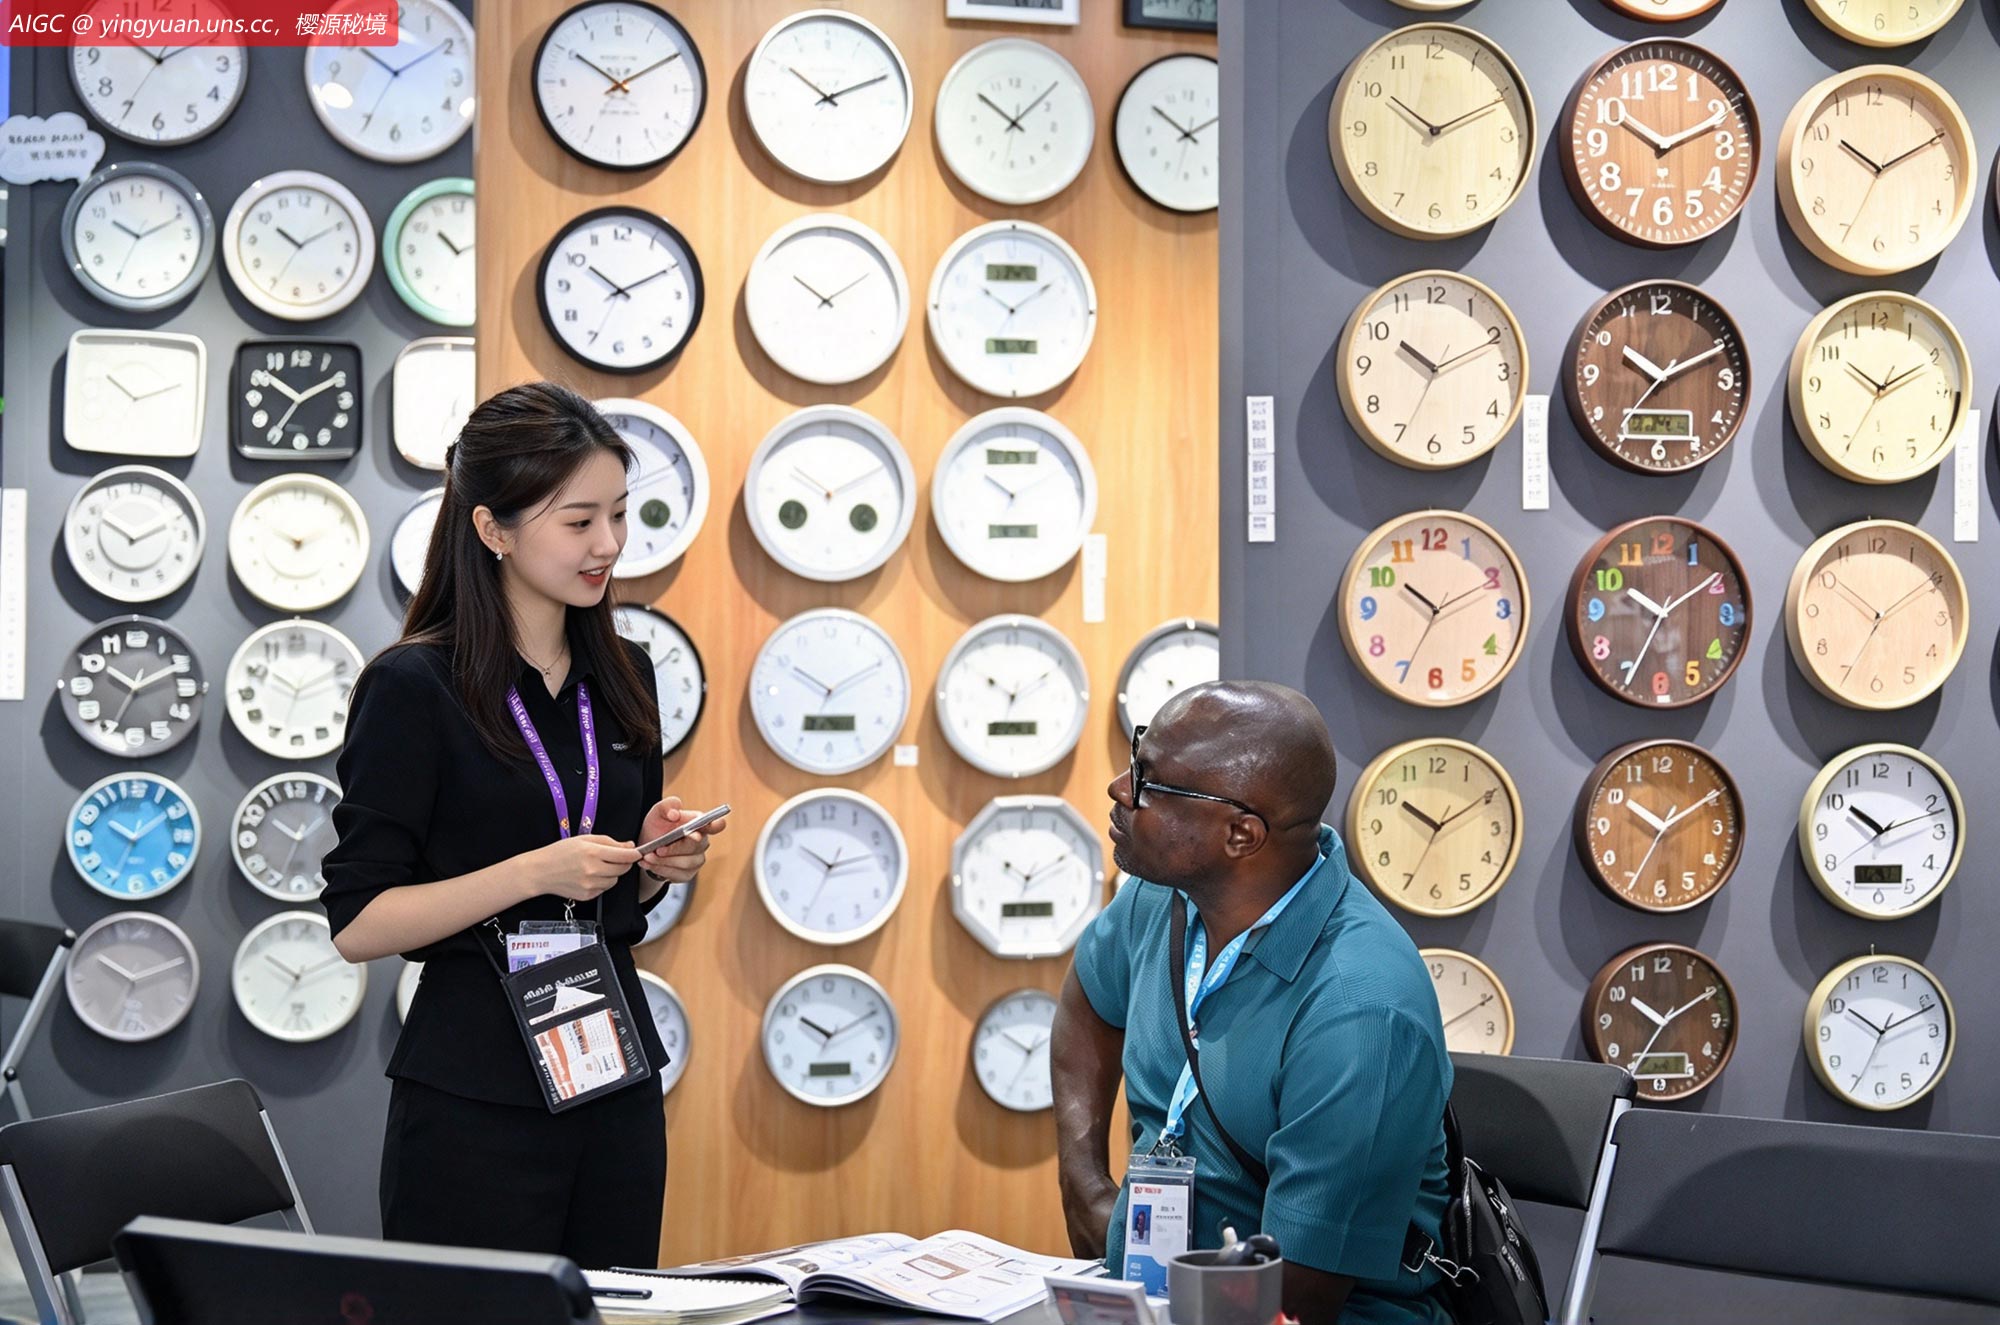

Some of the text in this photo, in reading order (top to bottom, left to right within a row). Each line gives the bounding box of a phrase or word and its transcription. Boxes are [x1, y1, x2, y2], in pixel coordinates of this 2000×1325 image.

[1874, 13, 1885, 31] 6
[88, 48, 100, 65] 9
[1426, 44, 1444, 60] 12
[216, 55, 229, 73] 3
[1392, 56, 1404, 69] 11
[98, 77, 113, 96] 8
[1620, 71, 1645, 99] 11
[1648, 64, 1678, 91] 12
[1687, 72, 1700, 101] 1
[207, 86, 219, 101] 4
[1364, 82, 1382, 97] 10
[1866, 85, 1884, 106] 12
[122, 100, 134, 119] 7
[185, 104, 198, 123] 5
[1597, 97, 1627, 126] 10
[1835, 93, 1849, 116] 11
[152, 112, 165, 131] 6
[1353, 121, 1367, 136] 9
[389, 124, 401, 142] 6
[1500, 127, 1514, 143] 3
[1587, 128, 1608, 157] 9
[1365, 162, 1378, 176] 8
[1490, 167, 1502, 180] 4
[1801, 157, 1814, 176] 9
[1600, 162, 1621, 191] 8
[1702, 166, 1726, 194] 4
[1394, 193, 1405, 207] 7
[1466, 195, 1478, 210] 5
[1625, 188, 1645, 217] 7
[1685, 190, 1704, 218] 5
[1813, 197, 1826, 216] 8
[1428, 203, 1441, 219] 6
[1652, 197, 1674, 226] 6
[1839, 223, 1851, 243] 7
[1908, 225, 1920, 244] 5
[1873, 235, 1884, 252] 6
[1395, 293, 1408, 313] 11
[1427, 287, 1446, 304] 12
[1651, 295, 1672, 315] 12
[1367, 321, 1389, 340] 10
[1487, 326, 1501, 344] 2
[1357, 356, 1371, 376] 9
[1498, 362, 1510, 381] 3
[1583, 364, 1599, 386] 9
[1367, 395, 1379, 413] 8
[1486, 400, 1499, 418] 4
[1394, 423, 1407, 443] 7
[1462, 426, 1475, 444] 5
[1427, 434, 1441, 454] 6
[1651, 440, 1666, 460] 6
[1421, 528, 1448, 550] 12
[1651, 533, 1674, 555] 12
[1392, 538, 1415, 563] 11
[1461, 537, 1470, 560] 1
[1618, 543, 1644, 566] 11
[1687, 543, 1698, 565] 1
[1368, 566, 1395, 588] 10
[1596, 568, 1623, 591] 10
[1360, 596, 1377, 620] 9
[1496, 598, 1511, 619] 3
[1588, 597, 1605, 622] 9
[1369, 635, 1385, 656] 8
[1483, 633, 1498, 655] 4
[1593, 635, 1610, 660] 8
[1395, 660, 1410, 684] 7
[1462, 659, 1476, 682] 5
[1685, 661, 1700, 686] 5
[1903, 666, 1915, 684] 5
[1870, 675, 1883, 692] 6
[1403, 765, 1416, 782] 11
[1429, 757, 1446, 774] 12
[1652, 756, 1673, 773] 12
[1872, 762, 1890, 778] 12
[1627, 765, 1642, 783] 11
[1847, 769, 1859, 788] 11
[1378, 788, 1397, 804] 10
[1827, 794, 1844, 810] 10
[1371, 819, 1382, 835] 9
[1491, 821, 1500, 836] 3
[1711, 820, 1723, 835] 3
[1816, 824, 1828, 840] 9
[1932, 823, 1946, 840] 3
[1378, 851, 1390, 866] 8
[1825, 854, 1837, 871] 8
[1922, 854, 1935, 870] 4
[1403, 873, 1413, 891] 7
[1459, 874, 1471, 891] 5
[1654, 880, 1667, 898] 6
[1682, 872, 1696, 890] 5
[1904, 878, 1915, 894] 5
[1430, 884, 1442, 899] 6
[1654, 957, 1672, 973] 12
[1486, 1021, 1495, 1036] 3
[1600, 1013, 1612, 1030] 9
[1820, 1026, 1831, 1042] 9
